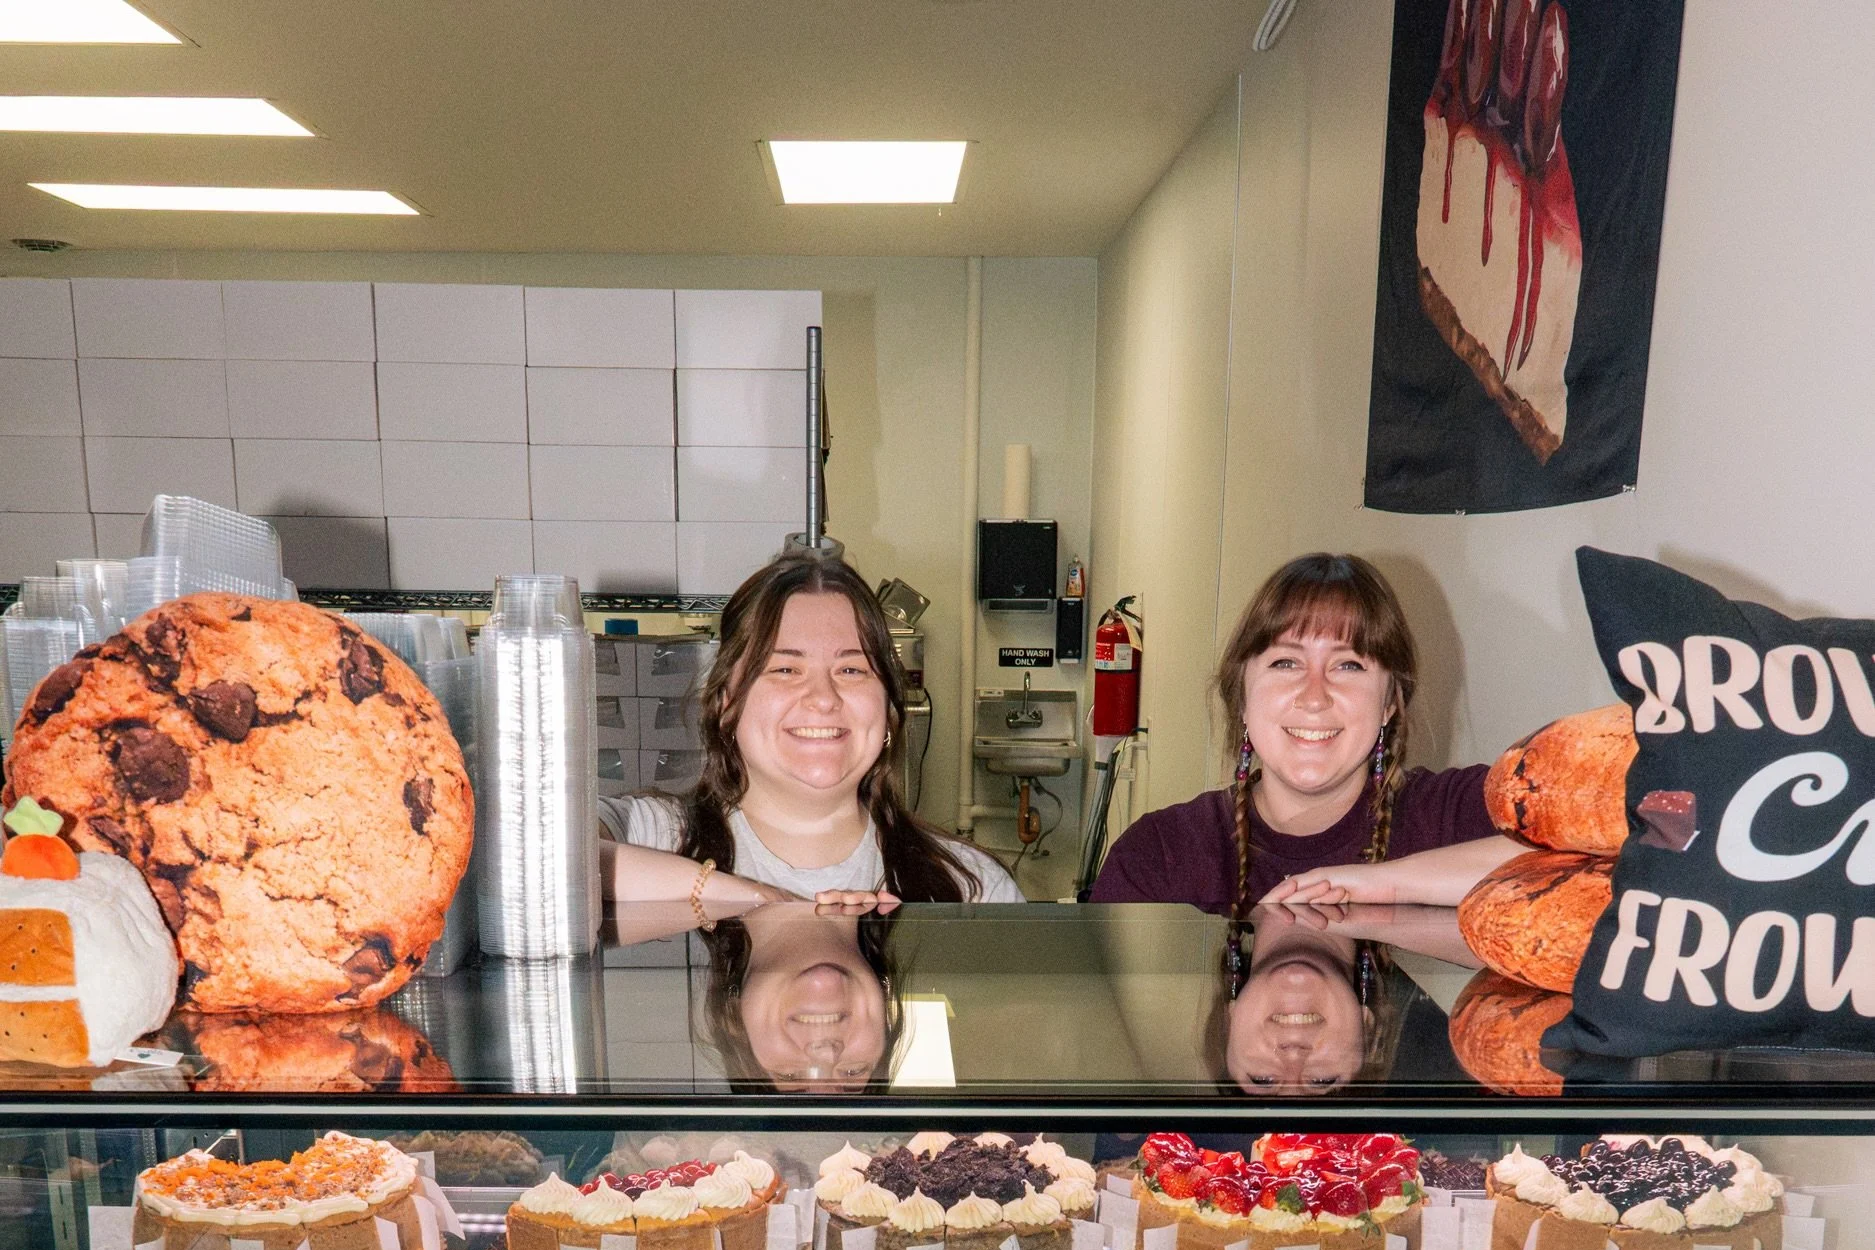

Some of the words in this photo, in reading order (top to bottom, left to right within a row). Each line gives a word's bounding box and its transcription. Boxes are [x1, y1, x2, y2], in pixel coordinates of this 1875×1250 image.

[1002, 649, 1025, 657] HAND
[1026, 649, 1049, 657] WASH
[1015, 658, 1036, 666] ONLY
